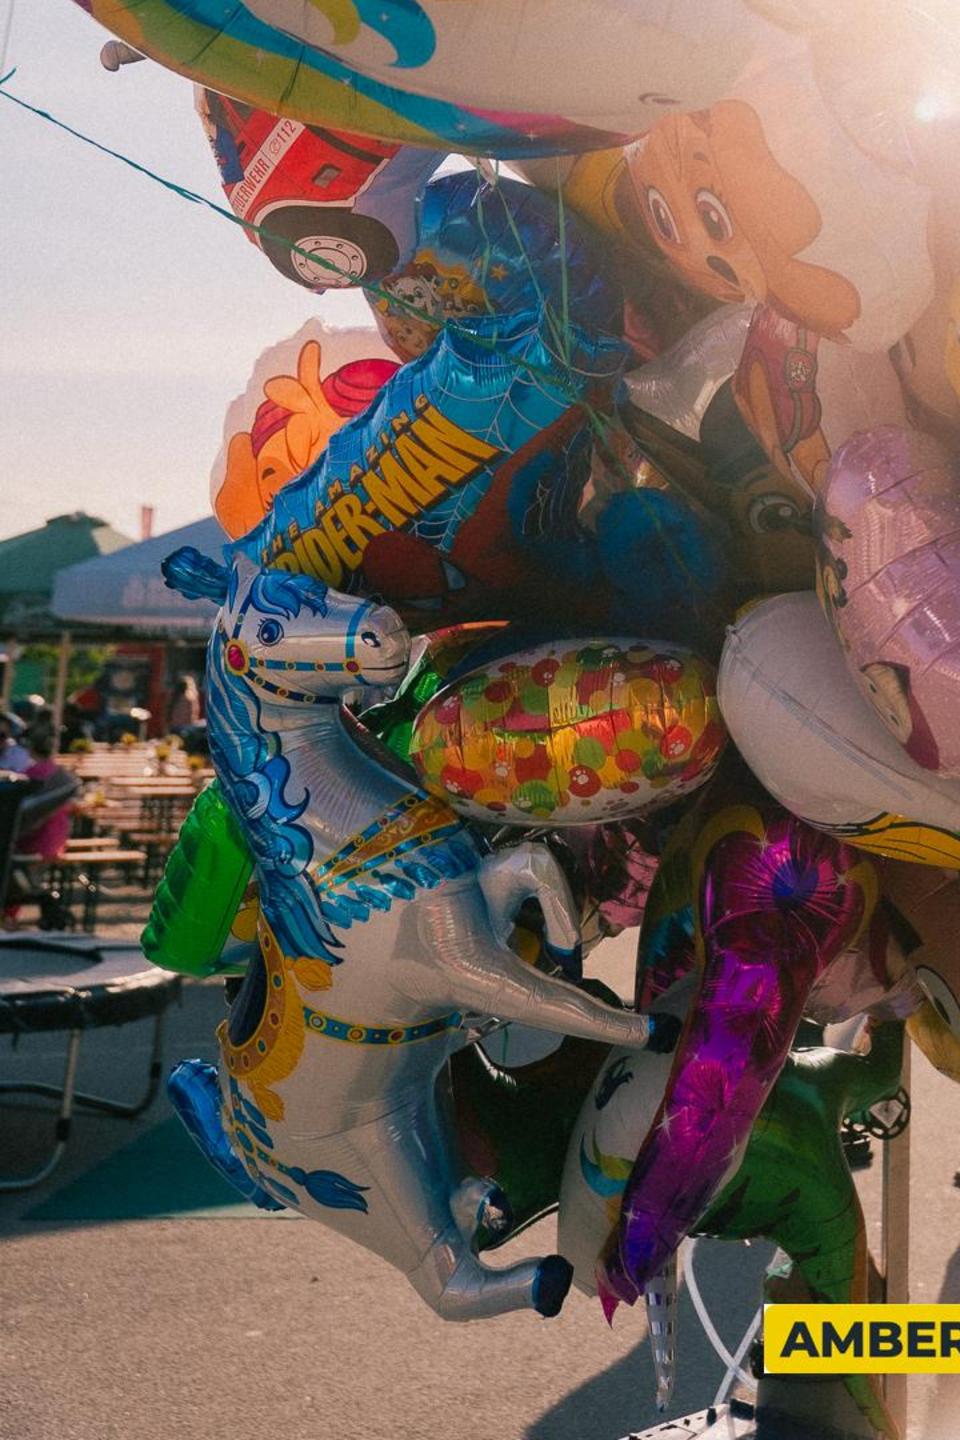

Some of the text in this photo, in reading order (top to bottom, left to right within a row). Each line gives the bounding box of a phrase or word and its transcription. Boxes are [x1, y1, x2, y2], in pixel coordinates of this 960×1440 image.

[277, 120, 297, 143] 112
[262, 393, 428, 563] THE AMAZING
[266, 405, 501, 589] PIDER-MAN
